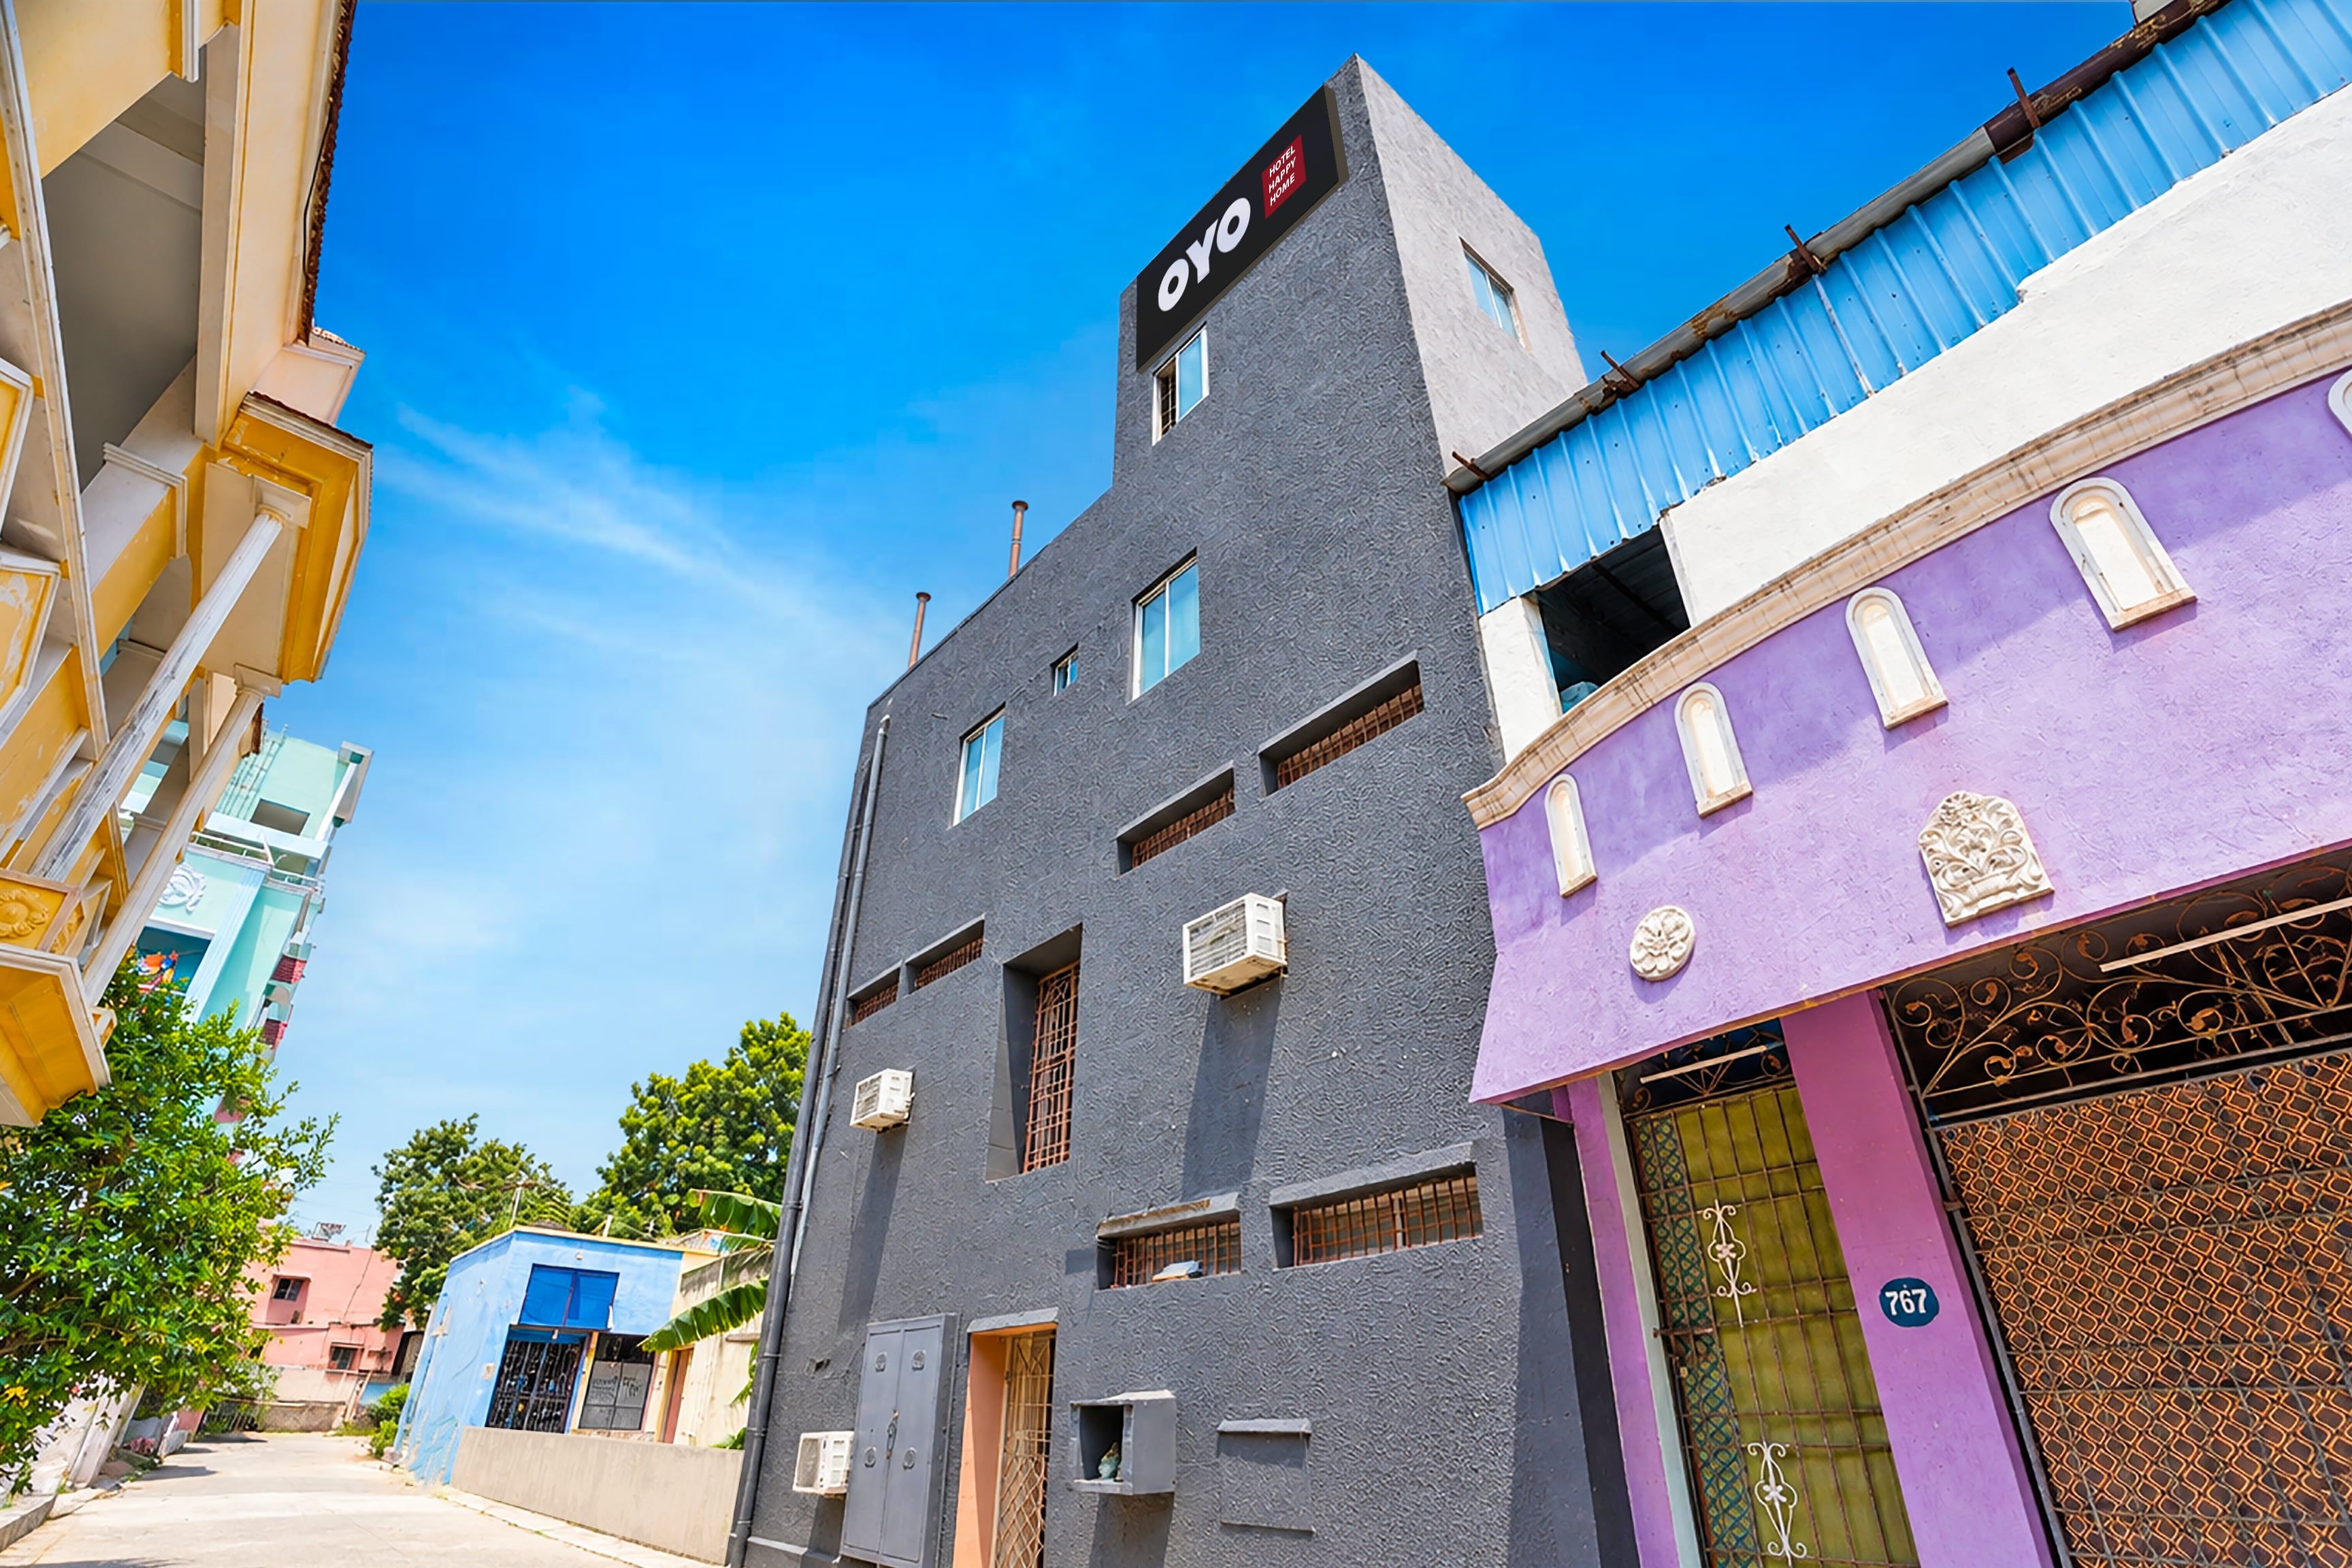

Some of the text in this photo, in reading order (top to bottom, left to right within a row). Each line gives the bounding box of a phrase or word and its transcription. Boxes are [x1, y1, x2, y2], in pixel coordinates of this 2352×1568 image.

[1269, 146, 1296, 178] HOTEL
[1269, 156, 1296, 193] HAPPY
[1270, 172, 1295, 206] HOME
[1158, 197, 1252, 312] OYO
[1884, 1288, 1927, 1316] 767
